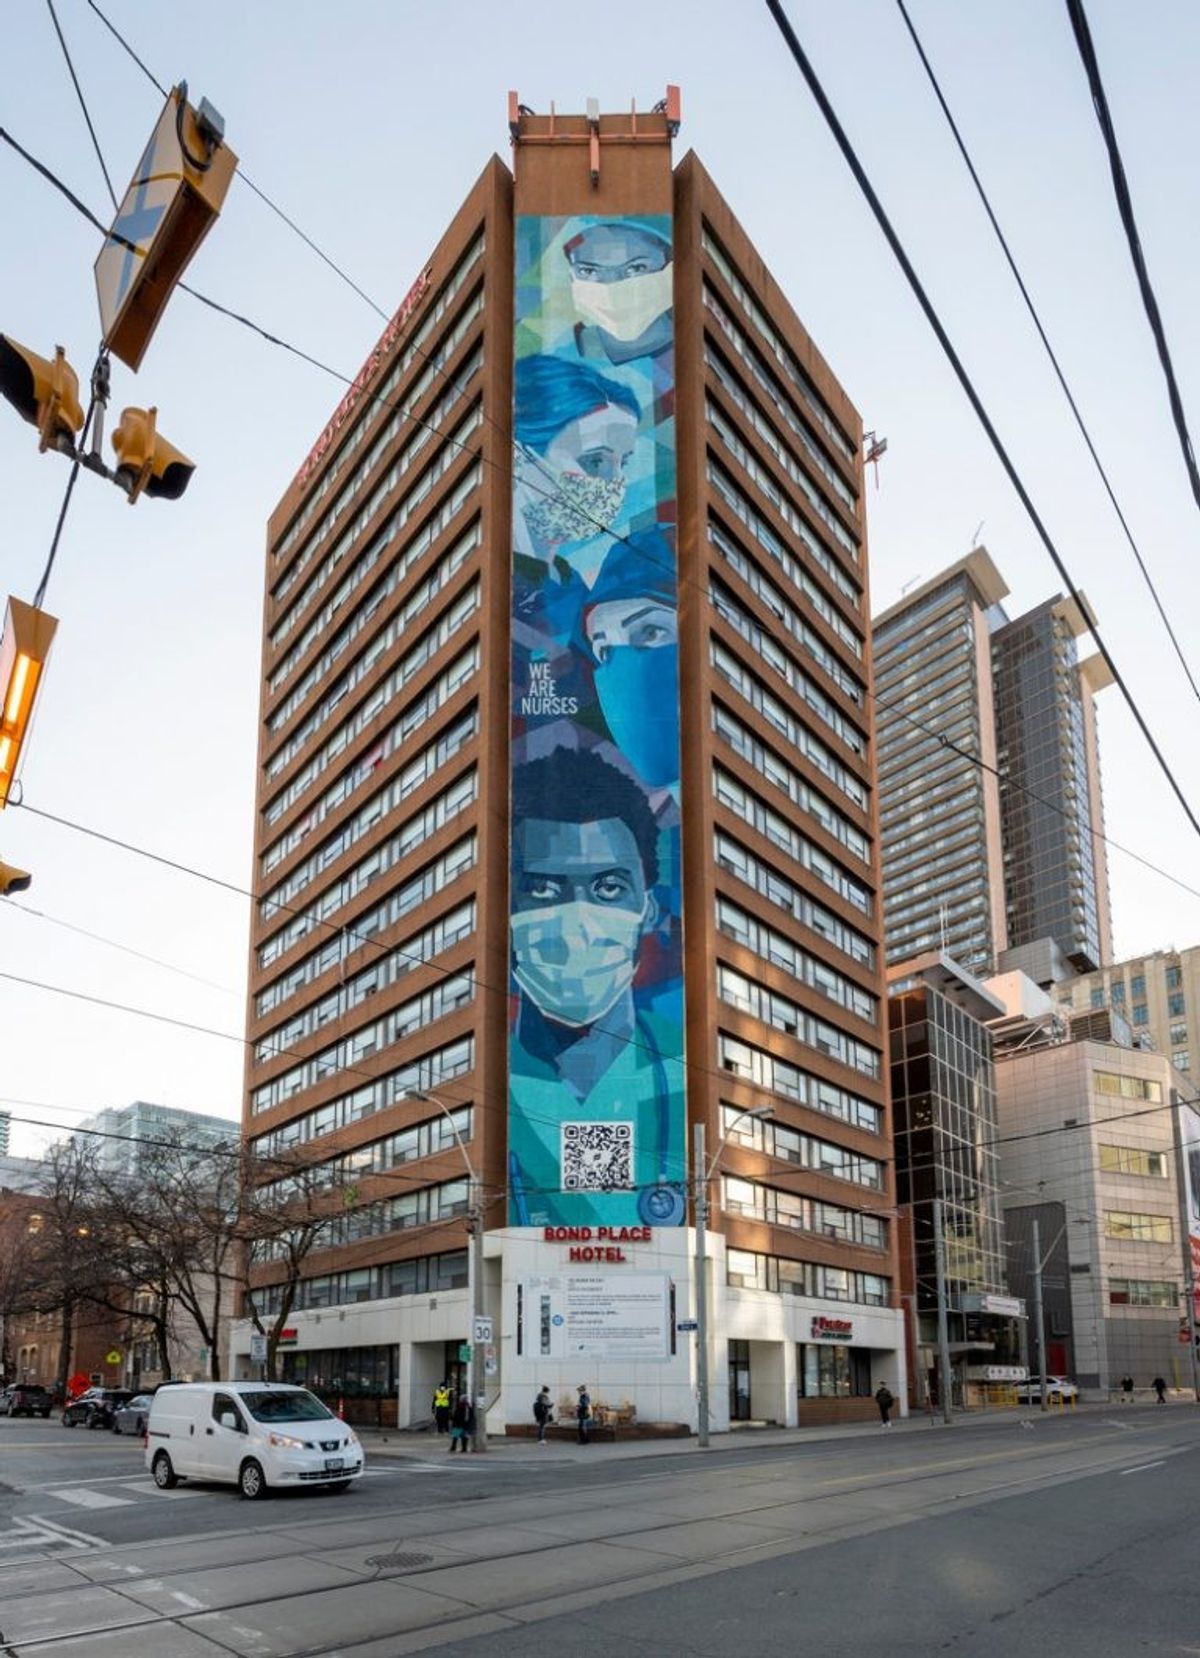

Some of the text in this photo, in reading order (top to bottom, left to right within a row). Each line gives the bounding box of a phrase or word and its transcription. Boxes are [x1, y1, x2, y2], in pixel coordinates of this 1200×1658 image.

[529, 663, 551, 680] WE
[529, 680, 557, 697] ARE
[521, 697, 578, 715] NURSES
[544, 1227, 652, 1242] BOND PLACE
[570, 1247, 625, 1262] HOTEL
[476, 1326, 490, 1340] 30
